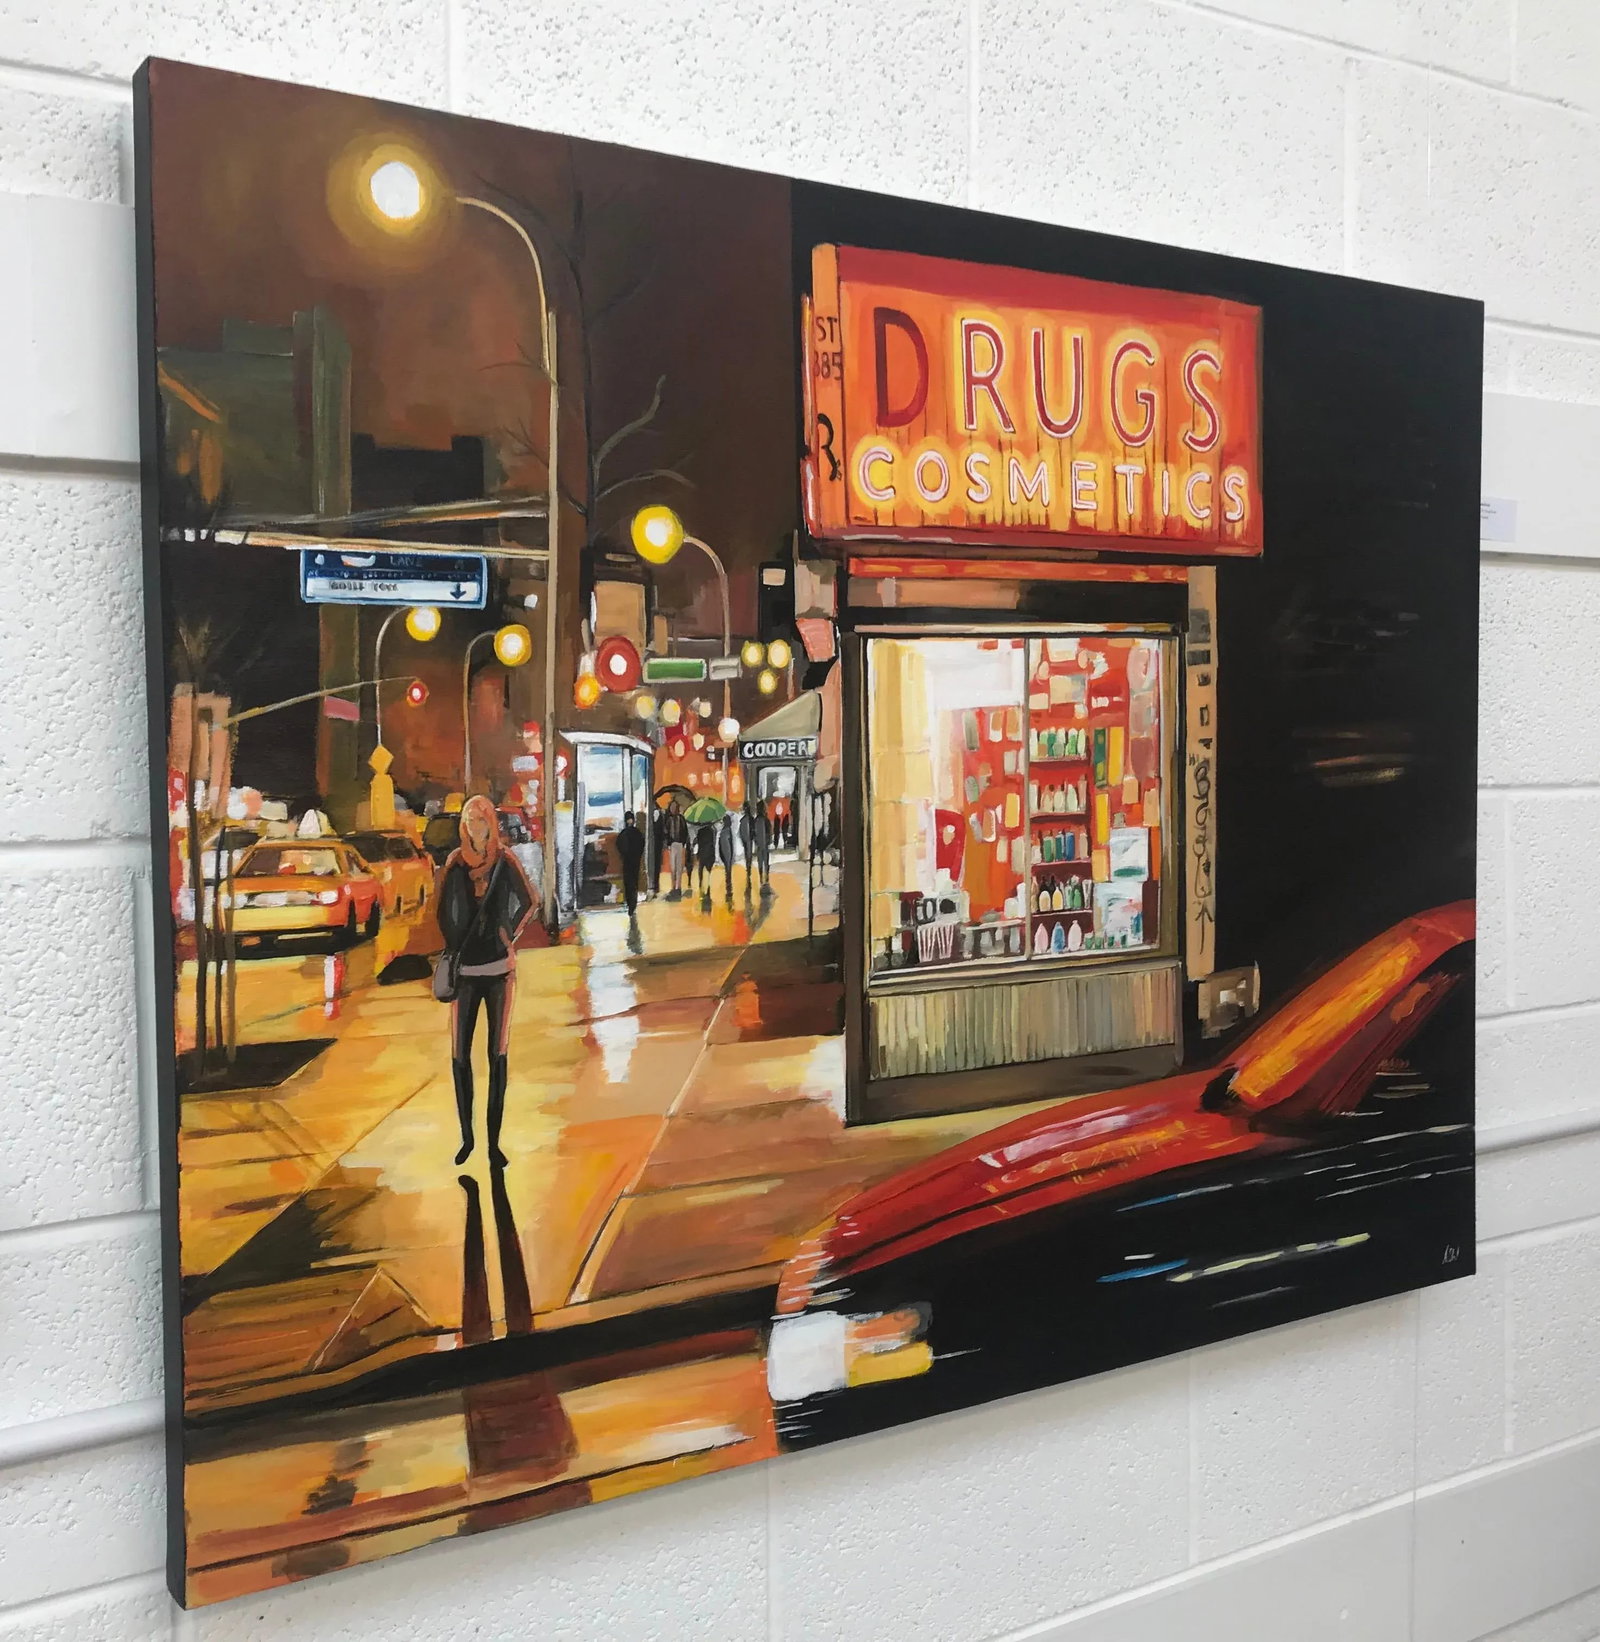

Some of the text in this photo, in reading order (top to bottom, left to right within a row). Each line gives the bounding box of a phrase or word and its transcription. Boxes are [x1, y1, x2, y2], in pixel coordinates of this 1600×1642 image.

[815, 316, 838, 343] ST
[873, 306, 1222, 452] DRUGS
[857, 445, 1246, 523] COSMETICS
